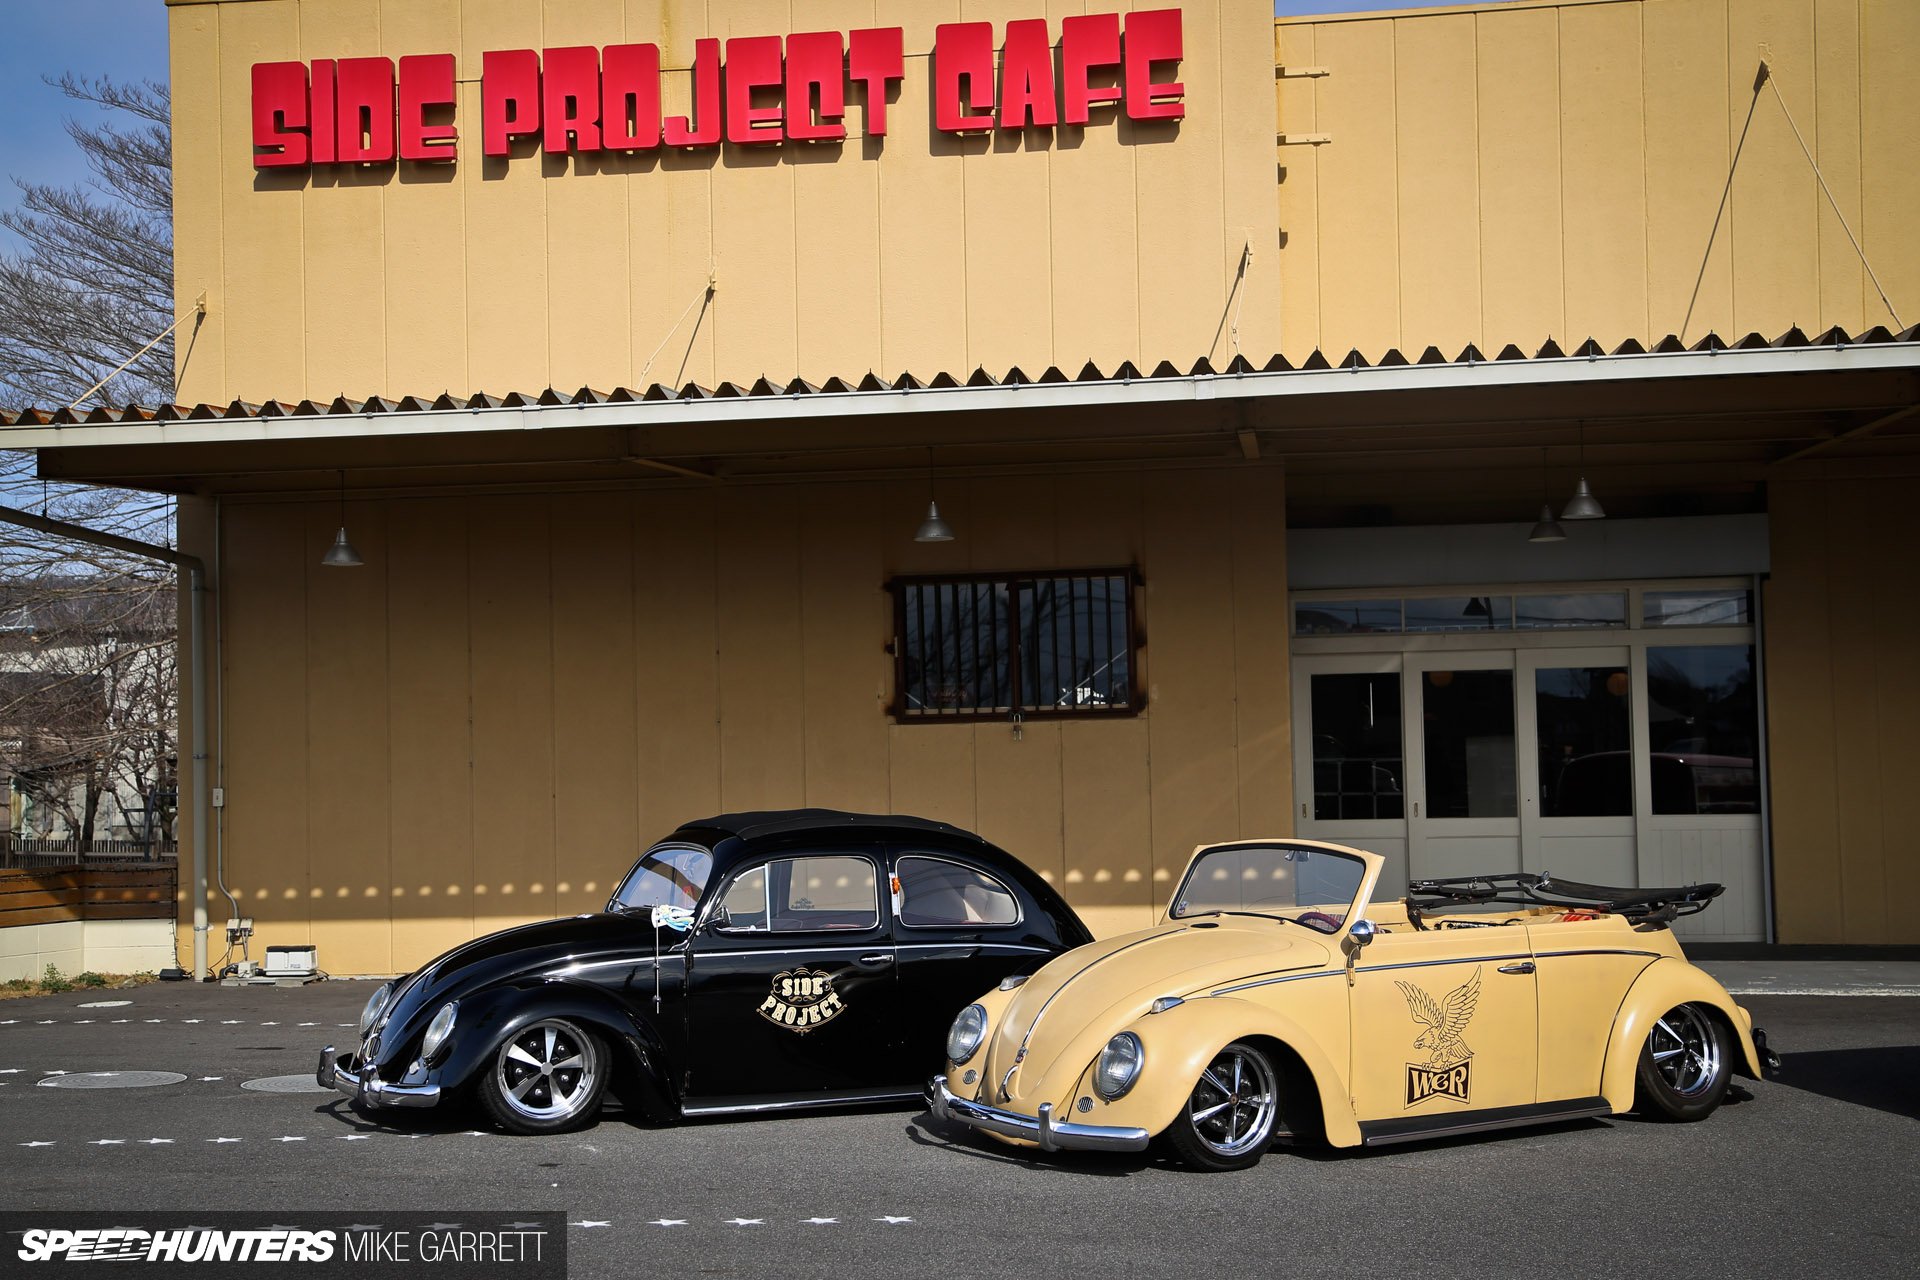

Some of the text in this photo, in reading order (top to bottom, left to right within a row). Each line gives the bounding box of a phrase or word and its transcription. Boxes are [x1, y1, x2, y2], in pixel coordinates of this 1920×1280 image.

[251, 8, 1185, 168] SIDE PROJECT CAFE
[781, 977, 824, 997] SIDE
[760, 992, 843, 1026] PROJECT
